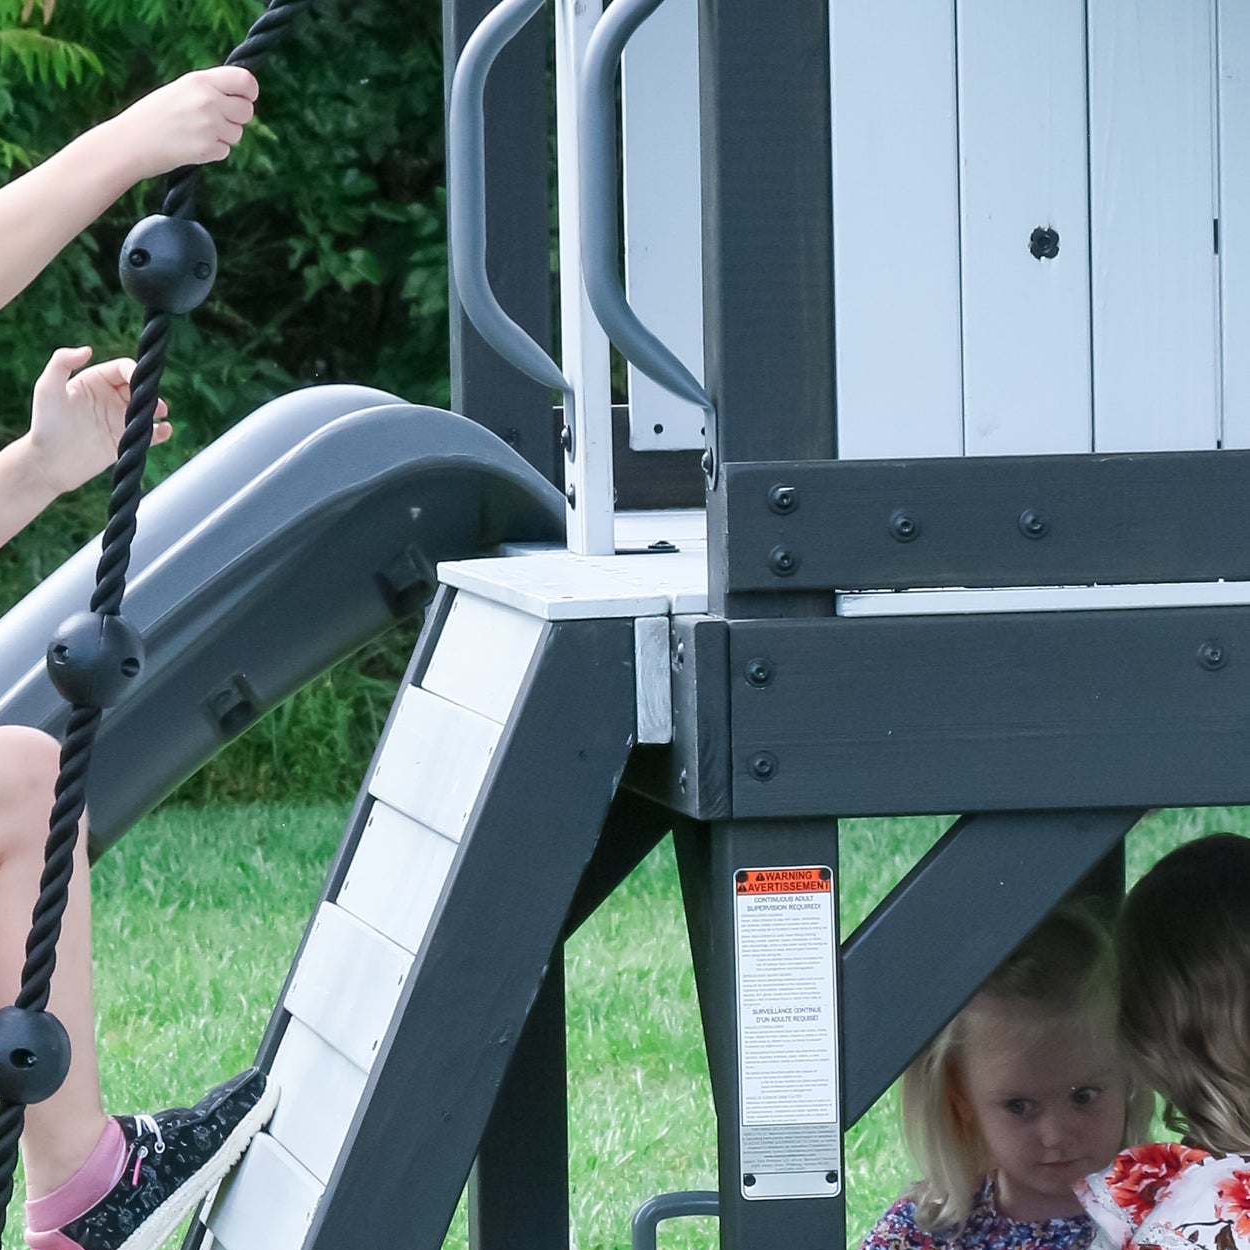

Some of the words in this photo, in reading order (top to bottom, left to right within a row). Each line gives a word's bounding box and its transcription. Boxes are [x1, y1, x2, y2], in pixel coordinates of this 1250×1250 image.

[765, 871, 813, 881] WARNING
[748, 881, 829, 892] AVERTISSEMENT
[752, 1007, 792, 1015] SURVEILLANCE
[794, 1006, 822, 1014] CONTINUE
